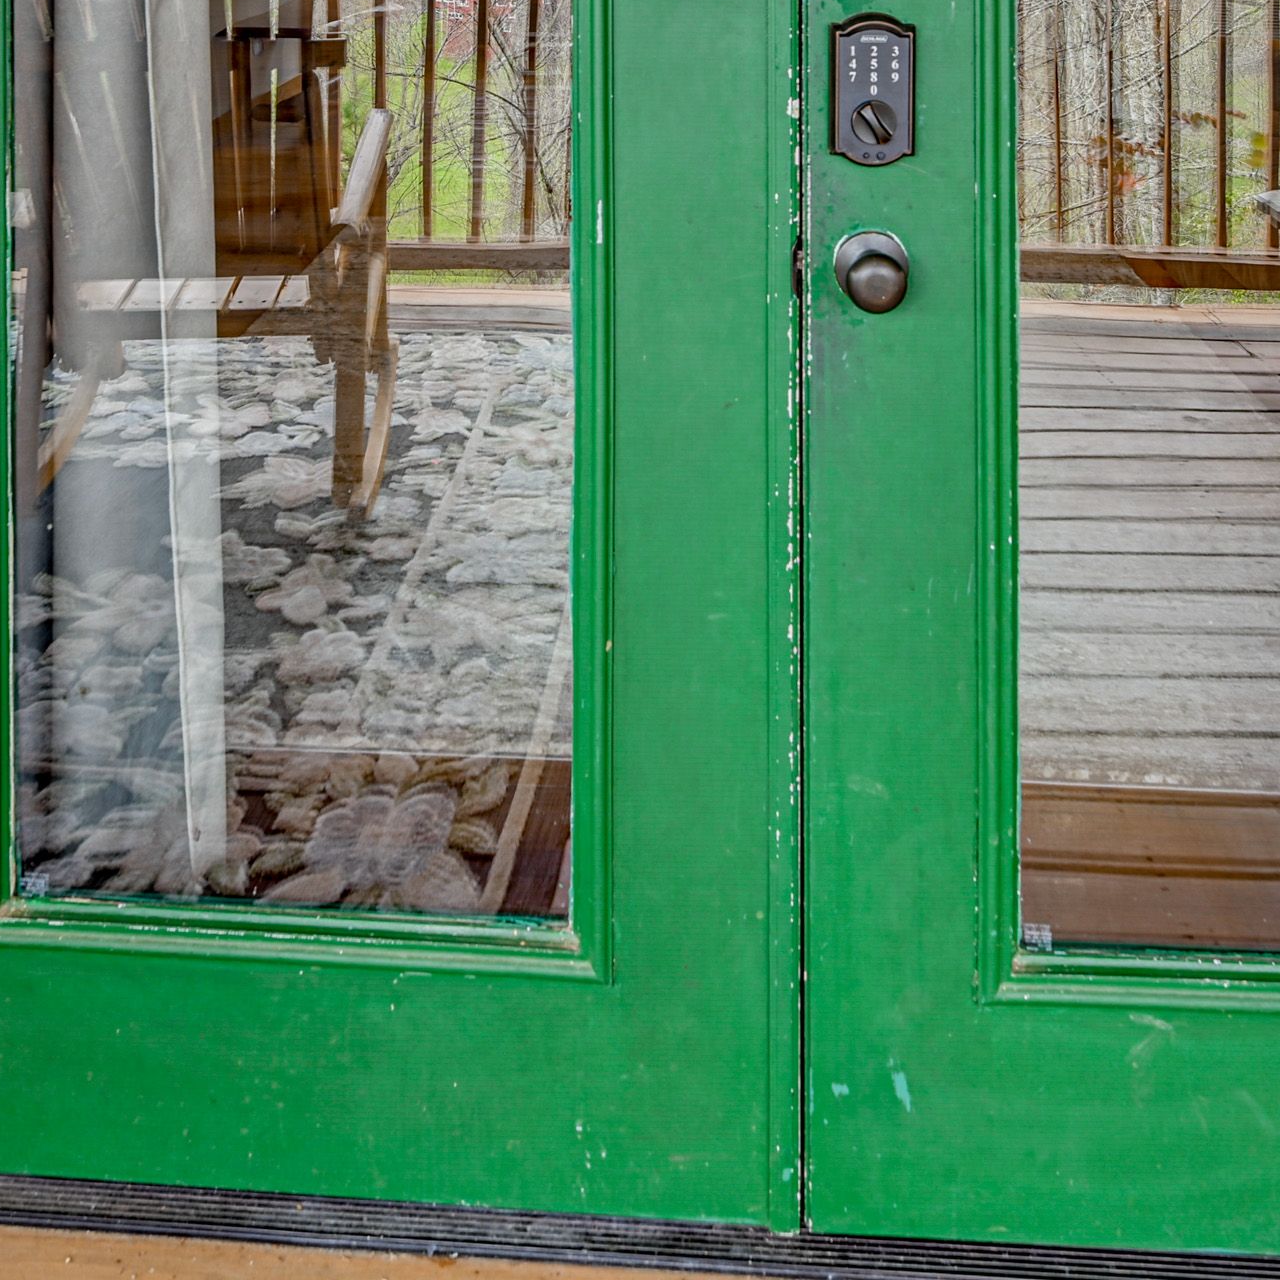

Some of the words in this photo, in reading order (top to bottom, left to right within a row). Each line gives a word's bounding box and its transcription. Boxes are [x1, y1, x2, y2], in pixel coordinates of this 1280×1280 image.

[850, 45, 856, 57] 1
[870, 45, 878, 57] 2
[891, 45, 900, 57] 3
[848, 58, 857, 69] 4
[870, 58, 878, 70] 5
[891, 59, 899, 70] 6
[849, 71, 857, 82] 7
[870, 71, 878, 83] 8
[891, 72, 899, 83] 9
[870, 85, 878, 96] 0
